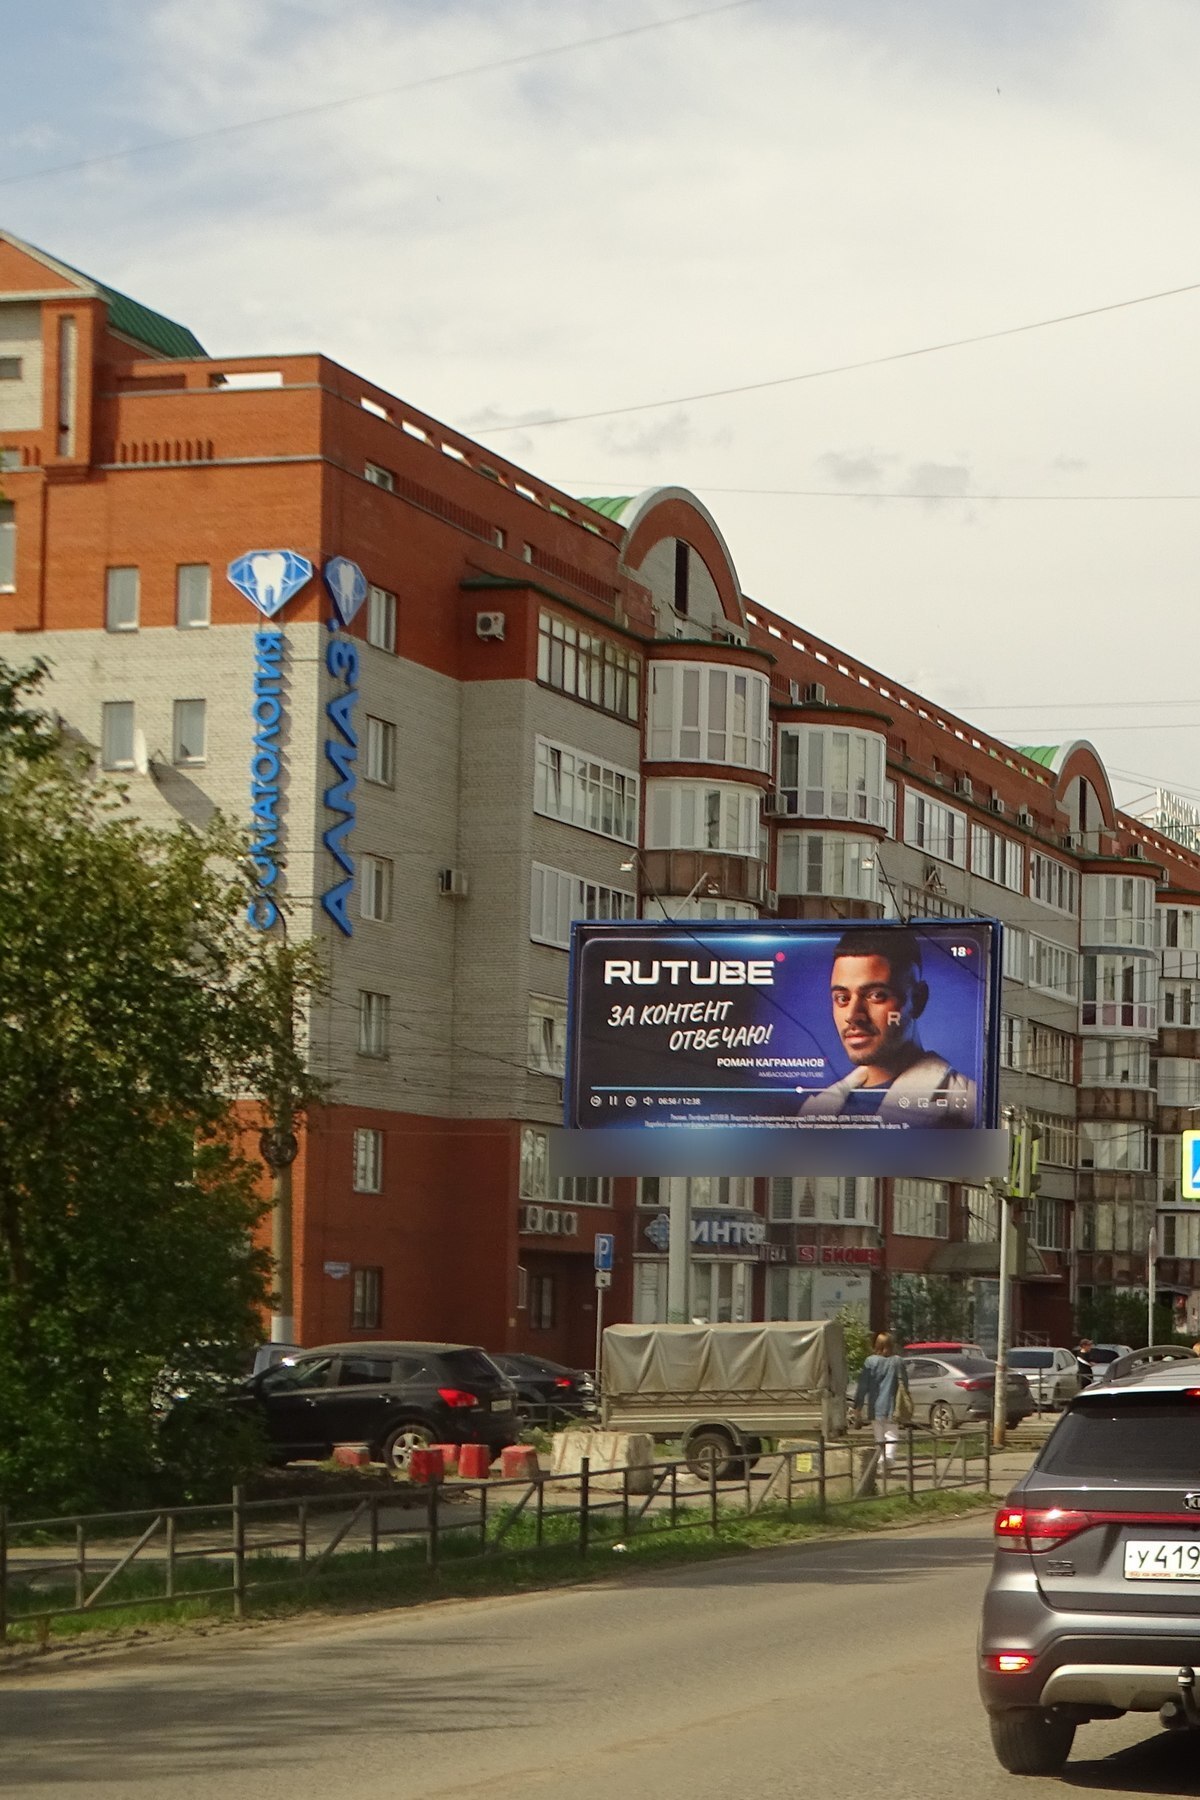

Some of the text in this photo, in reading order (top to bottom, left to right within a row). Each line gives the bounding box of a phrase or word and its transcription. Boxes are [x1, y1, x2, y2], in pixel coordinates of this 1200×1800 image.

[248, 631, 285, 931] СОМАТОЛОГИЯ
[321, 640, 360, 937] АЛМАЗ
[950, 946, 973, 957] 18+
[604, 960, 776, 985] RUTUBE
[607, 1000, 734, 1027] ЗА КОНТЕНТ
[669, 1023, 774, 1051] ОТВЕЧАЮ!
[716, 1057, 825, 1068] РОМАН КАГРАМАНОВ
